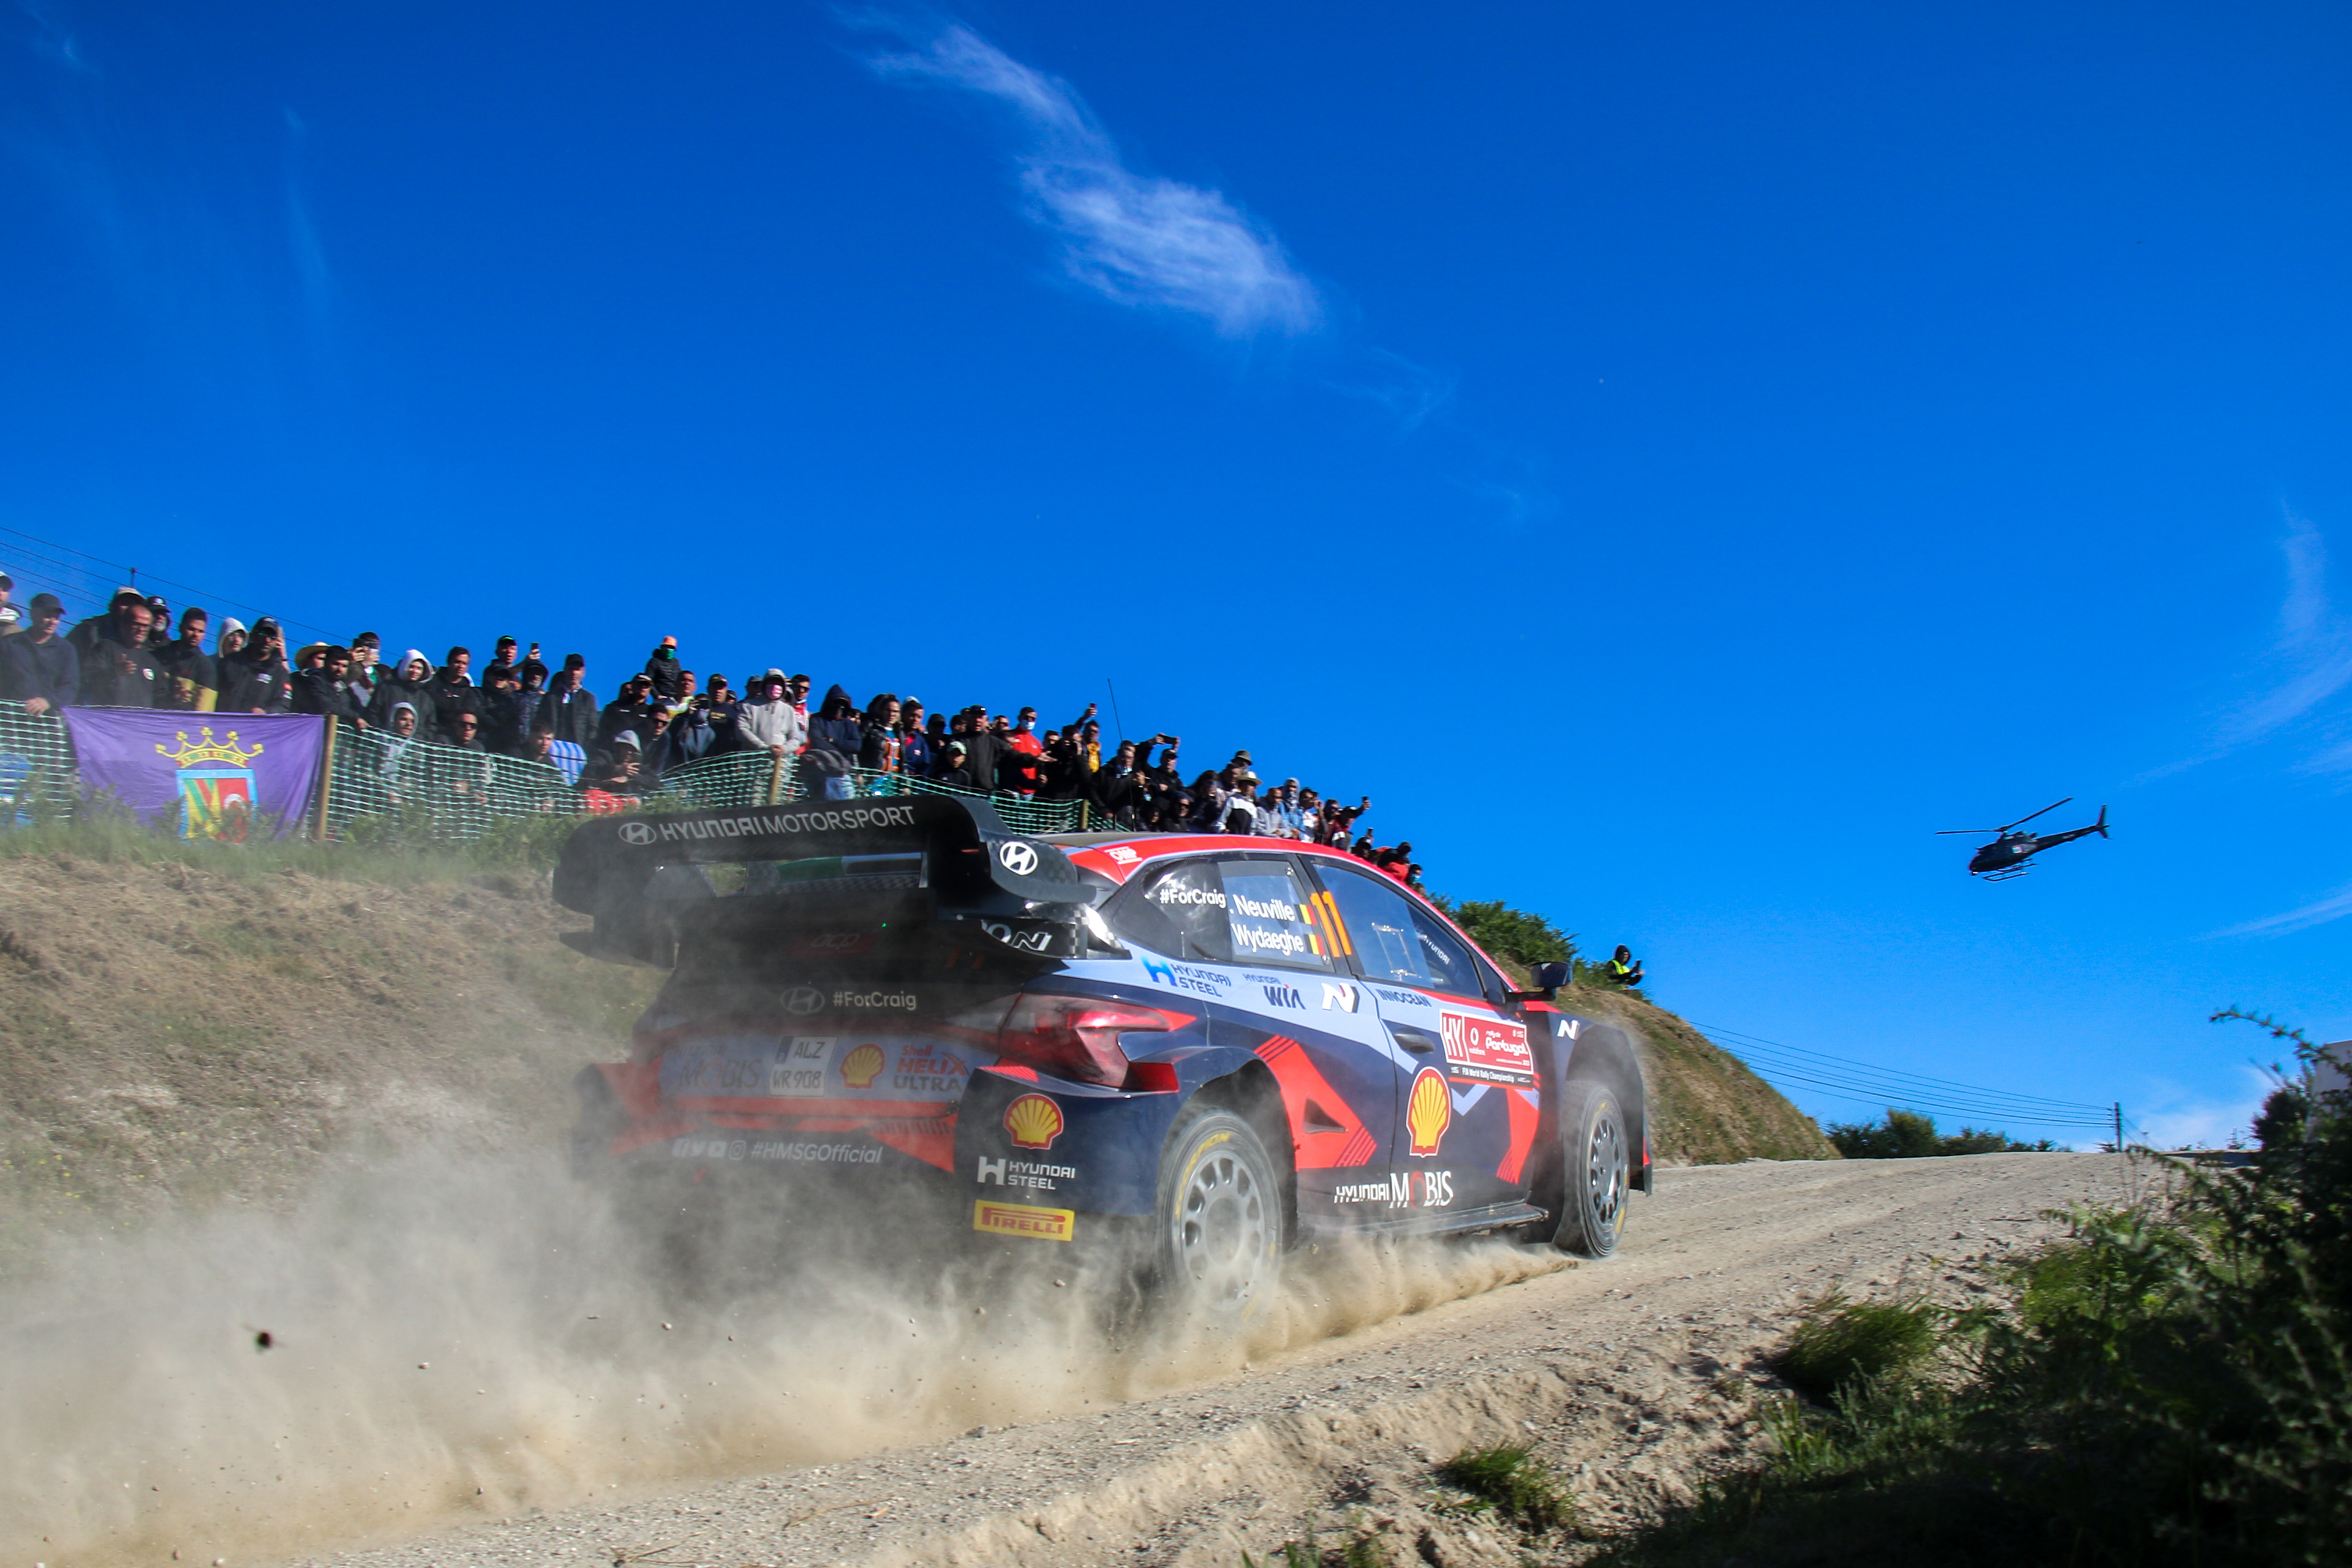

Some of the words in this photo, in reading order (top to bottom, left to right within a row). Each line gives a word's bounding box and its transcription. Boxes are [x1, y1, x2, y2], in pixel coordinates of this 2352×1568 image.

[658, 816, 764, 841] HYUNDAI
[761, 805, 916, 834] MOTORSPORT
[1107, 847, 1138, 862] OMP
[1159, 889, 1227, 908] #ForCraig
[1232, 894, 1296, 922] Neuville
[1310, 891, 1352, 958] 11
[1230, 923, 1305, 957] Wydaeghe
[1170, 963, 1231, 987] HYUNDAI
[1178, 977, 1223, 998] STEEL
[833, 990, 917, 1011] #ForCraig
[1443, 1016, 1463, 1058] HY
[1485, 1036, 1528, 1057] Portugal
[793, 1042, 825, 1059] ALZ
[902, 1045, 932, 1057] Shell
[897, 1052, 970, 1076] HELIX
[794, 1071, 821, 1090] 908
[892, 1075, 962, 1093] ULTRA
[750, 1142, 883, 1164] #HMSGOfficial
[1009, 1161, 1076, 1179] HYUNDAI
[1008, 1175, 1056, 1190] STEEL
[1333, 1183, 1390, 1204] HYUNDAI
[1388, 1170, 1453, 1210] MOBIS
[981, 1207, 1066, 1234] PIRELLI
